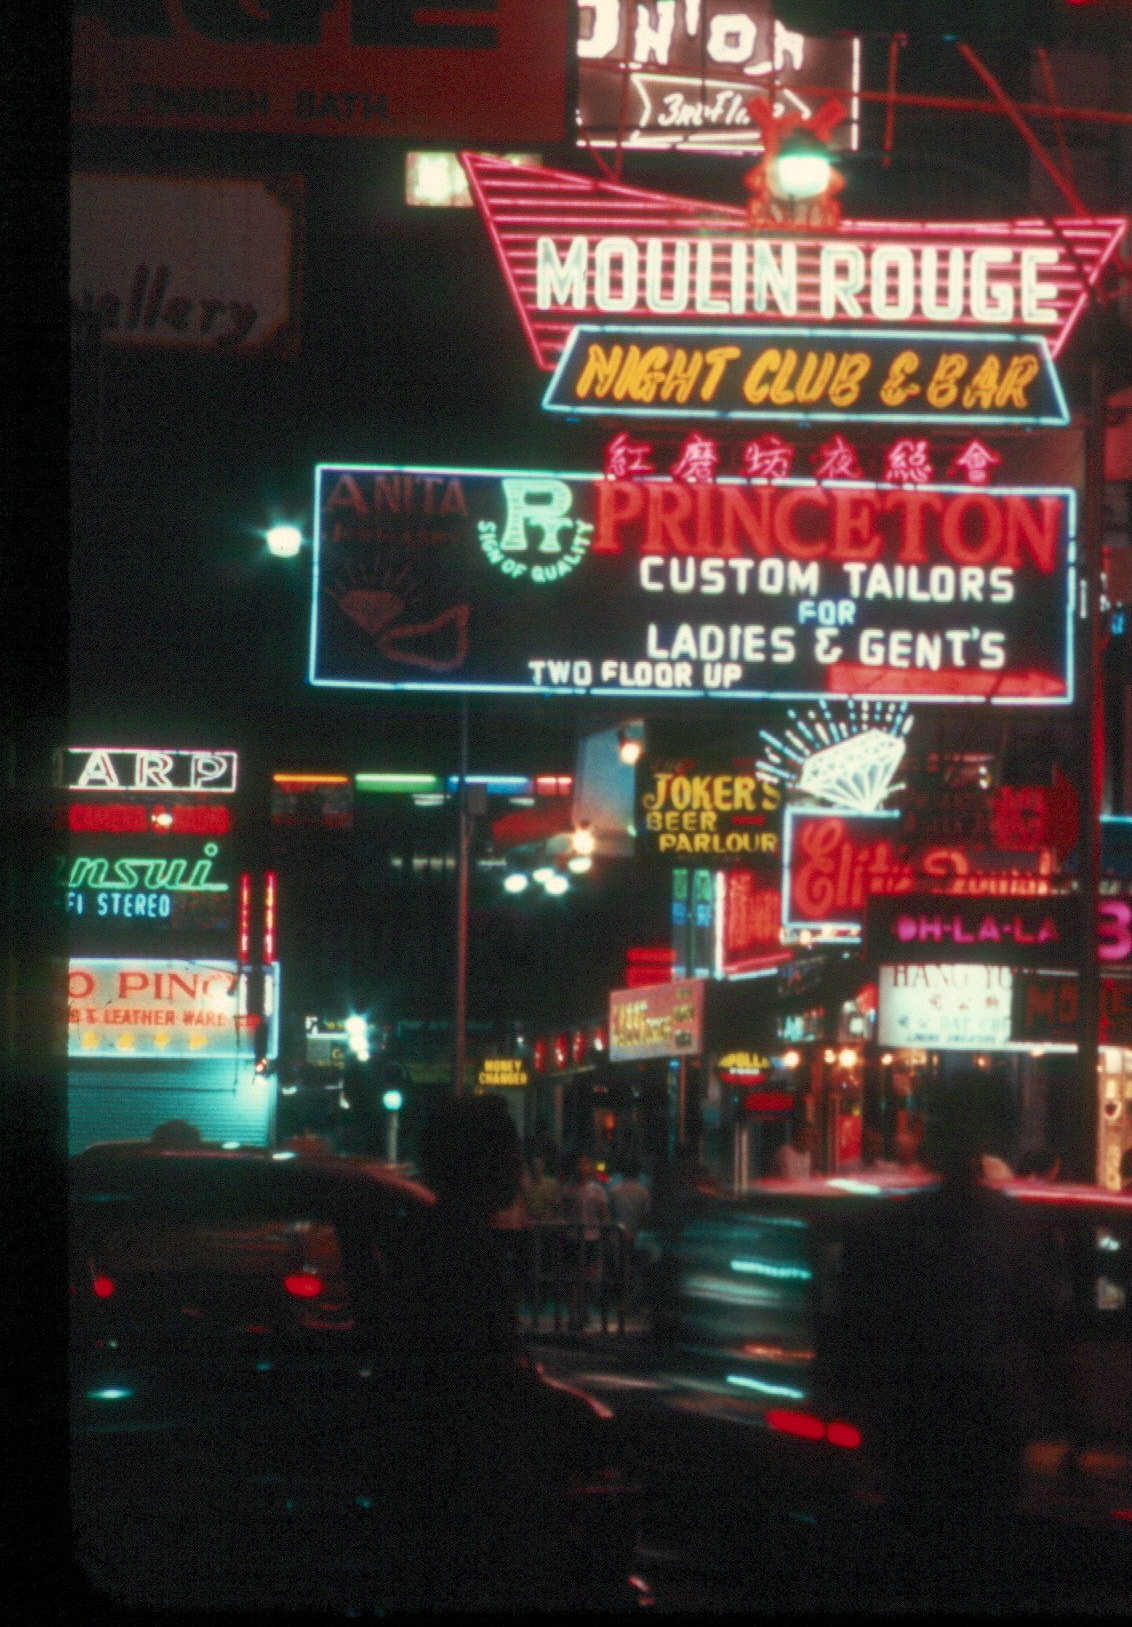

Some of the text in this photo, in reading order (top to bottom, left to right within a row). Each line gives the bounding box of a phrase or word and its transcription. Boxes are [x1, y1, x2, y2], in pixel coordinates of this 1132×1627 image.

[535, 237, 1060, 323] MOULIN ROUGE
[575, 344, 1039, 408] NIGHT CLUB & BAR
[326, 474, 468, 518] ANITA
[593, 479, 1066, 570] PRINCETON
[477, 520, 504, 565] SIGN
[501, 558, 528, 579] OF
[530, 519, 595, 583] QUALITY
[639, 555, 1016, 604] CUSTOM TAILORS
[798, 599, 856, 626] FOR
[646, 623, 1007, 670] LADIES & GENT'S
[528, 660, 743, 690] TWO FLOOR UP
[77, 749, 229, 790] ARP
[642, 772, 782, 811] JOKERS
[645, 810, 718, 832] BEER
[658, 832, 778, 853] PARLOUR
[97, 892, 171, 918] STEREO
[895, 915, 1060, 944] OH-LA-LA
[103, 1008, 175, 1027] LEATHER
